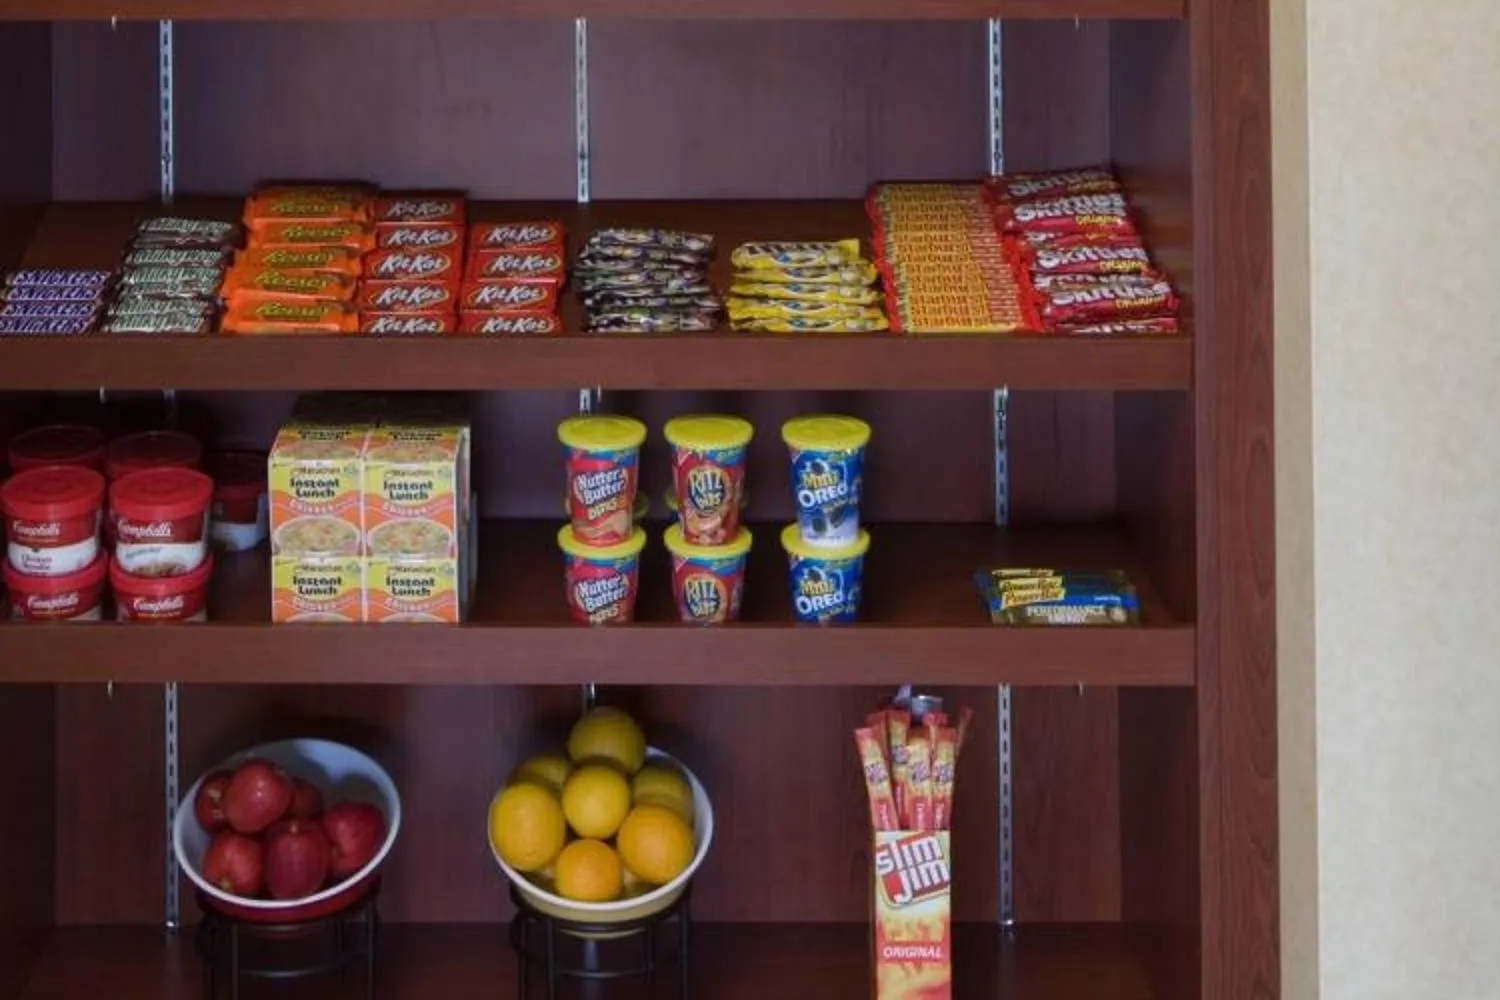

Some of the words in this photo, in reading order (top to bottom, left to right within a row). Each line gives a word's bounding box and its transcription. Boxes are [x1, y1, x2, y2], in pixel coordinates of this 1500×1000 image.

[289, 477, 340, 489] Instant
[577, 469, 625, 489] Nutter
[383, 480, 433, 491] Instant
[296, 487, 335, 498] Lunch
[390, 490, 429, 500] Lunch
[583, 480, 626, 505] Butter
[798, 484, 848, 507] OREO
[292, 576, 342, 587] Instant
[385, 576, 435, 588] Instant
[298, 585, 337, 596] Lunch
[391, 586, 431, 597] Lunch
[796, 592, 845, 614] OREO
[883, 945, 944, 959] ORIGINAL
